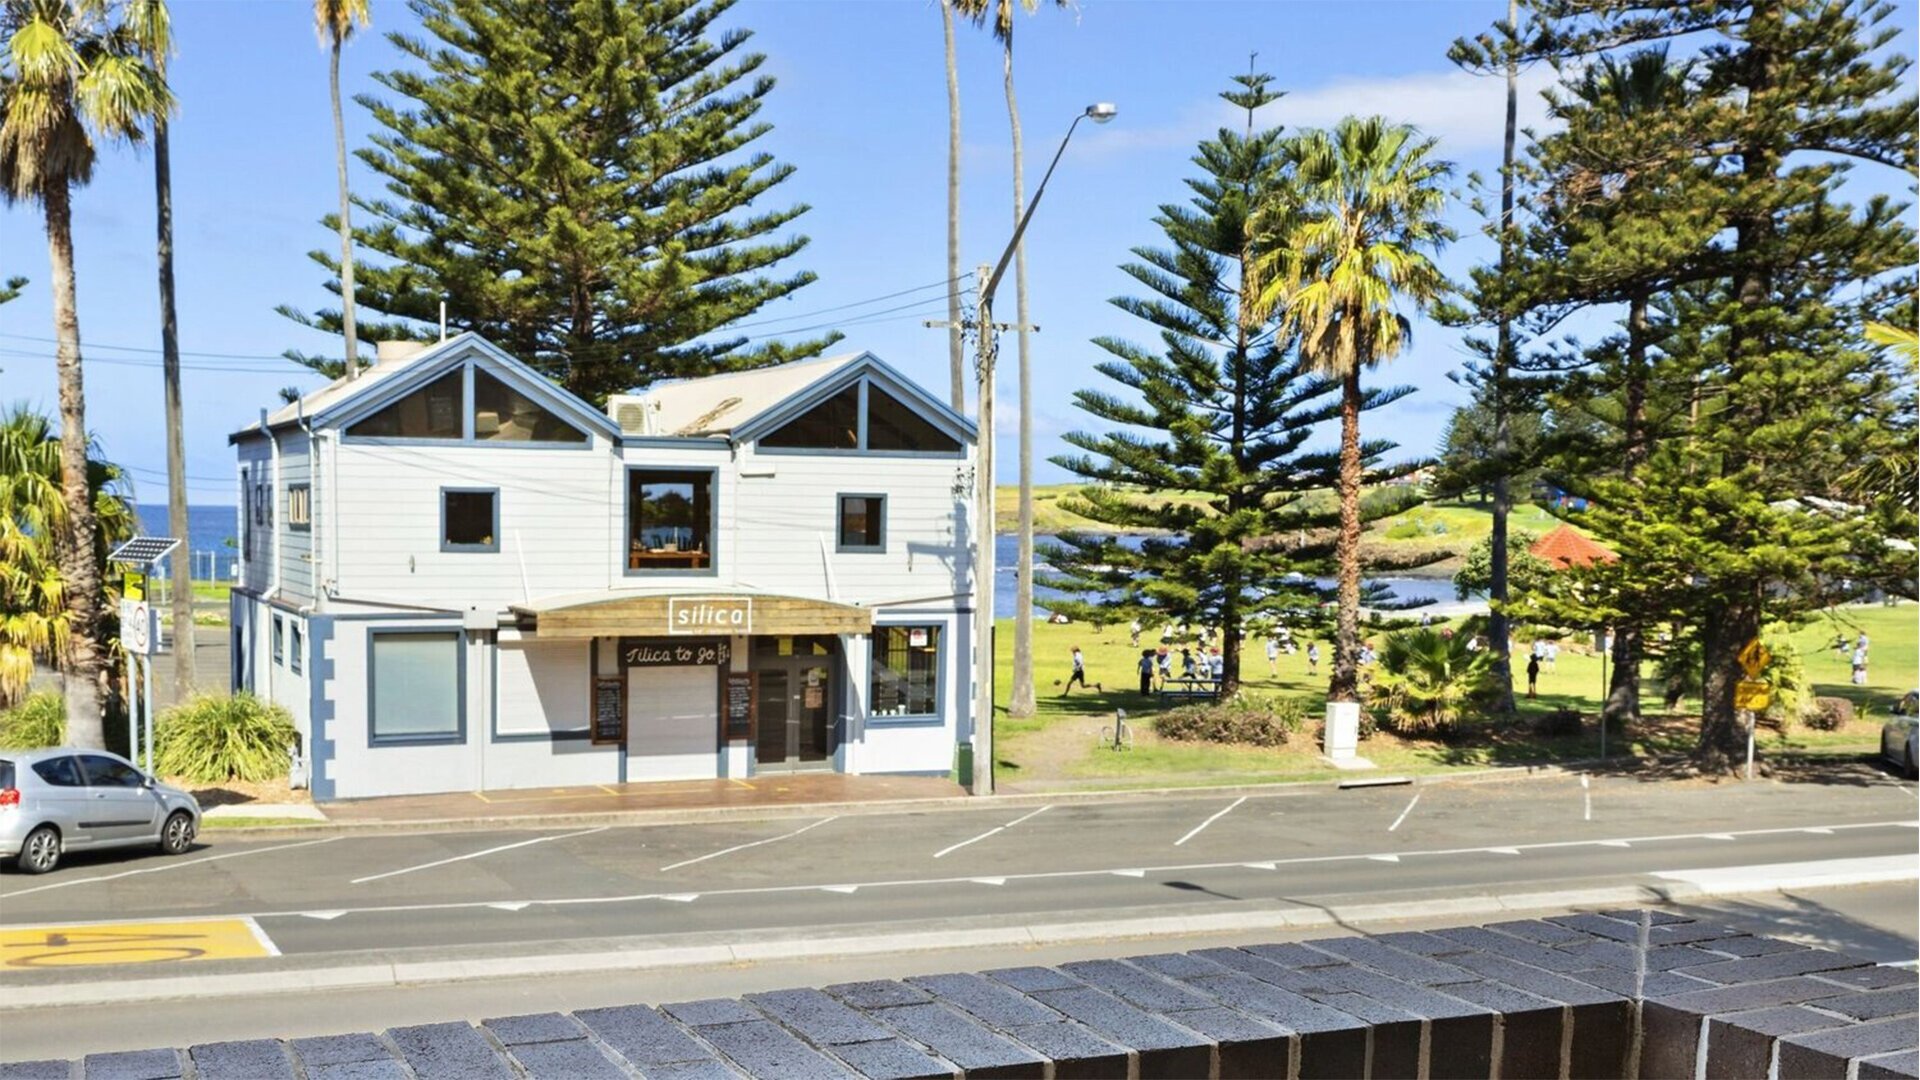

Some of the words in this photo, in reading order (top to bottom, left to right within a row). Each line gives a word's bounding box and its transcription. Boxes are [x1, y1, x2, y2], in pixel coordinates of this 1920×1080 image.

[678, 604, 743, 625] silica
[626, 647, 671, 663] Silica
[675, 646, 692, 661] to
